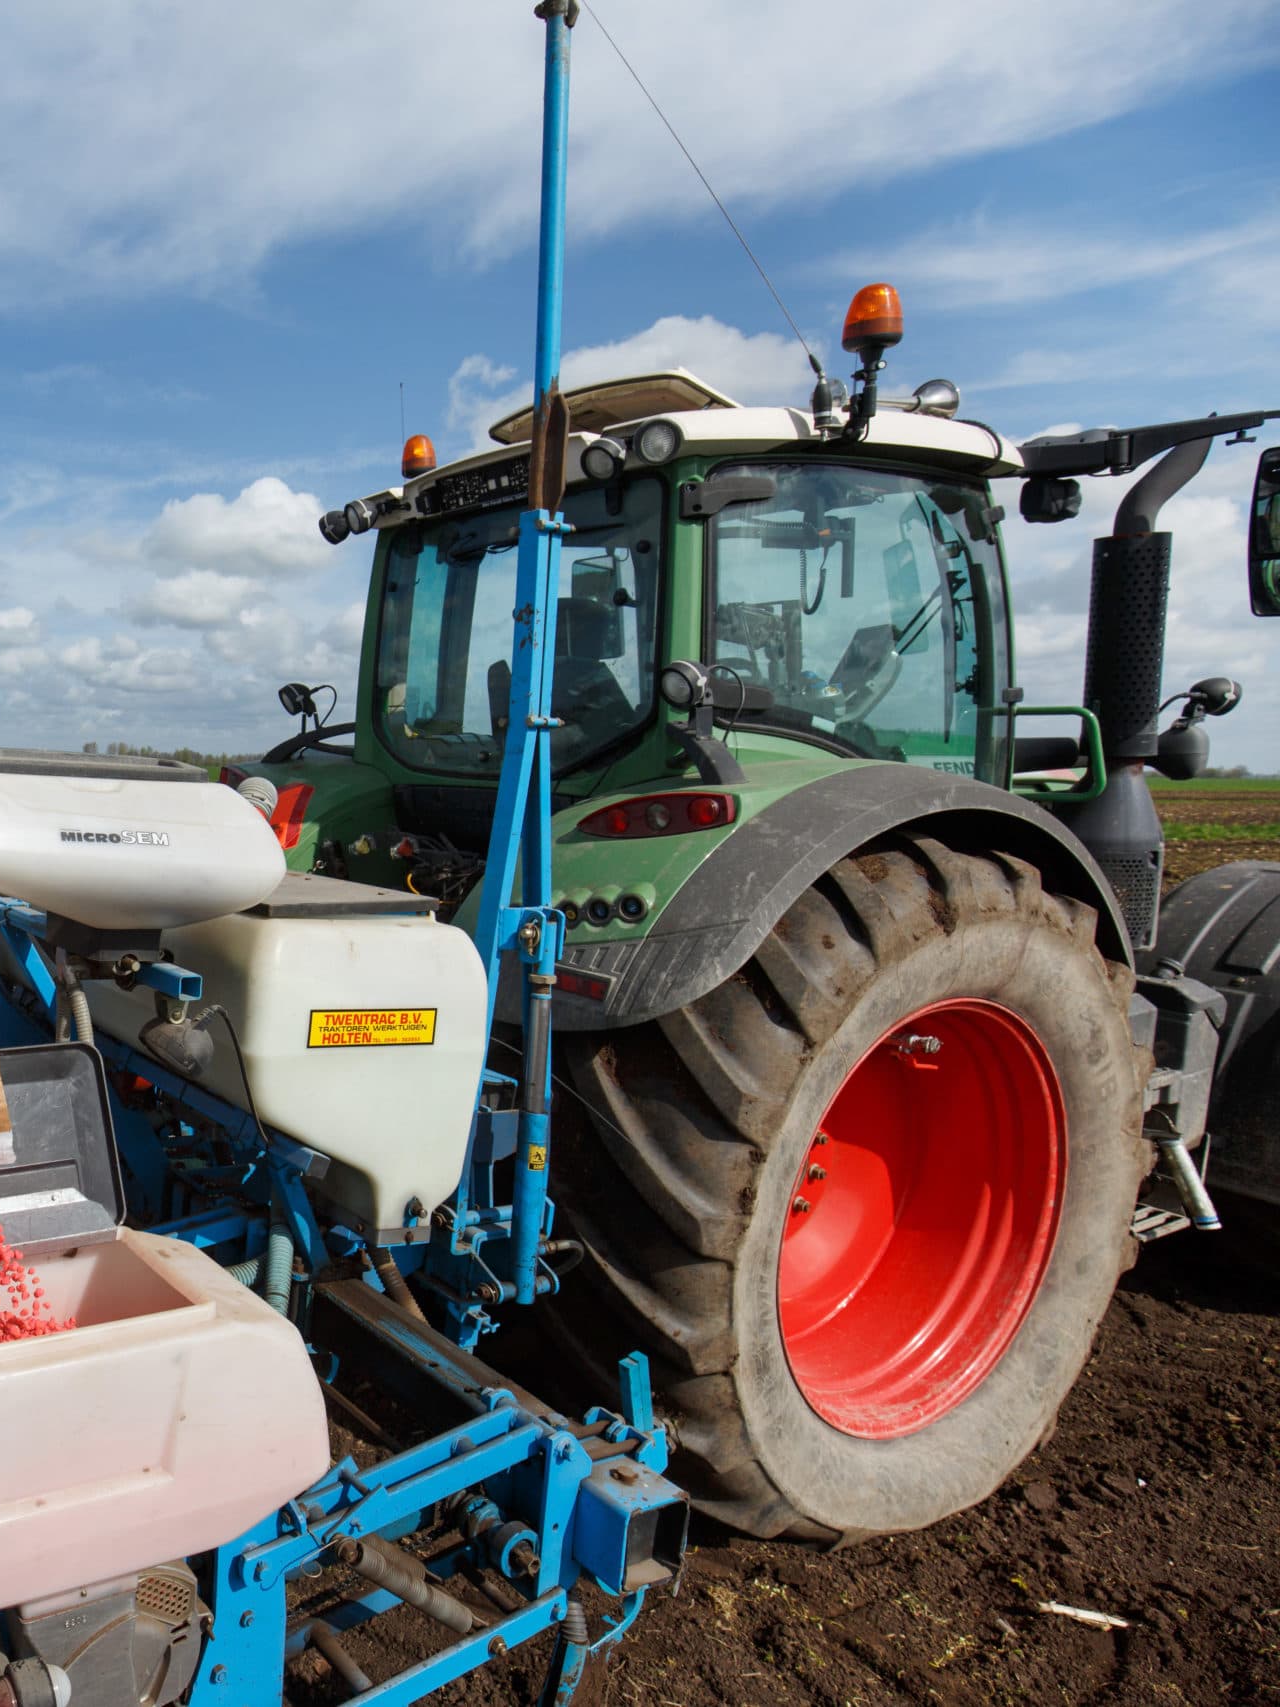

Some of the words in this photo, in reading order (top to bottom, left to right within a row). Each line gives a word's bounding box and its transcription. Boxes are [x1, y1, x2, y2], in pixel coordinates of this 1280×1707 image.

[933, 761, 974, 775] FEND
[324, 1013, 396, 1026] TWENTRAC
[400, 1013, 423, 1024] B.V.
[318, 1025, 370, 1033] TRAKTOREN
[322, 1032, 373, 1045] HOLTEN
